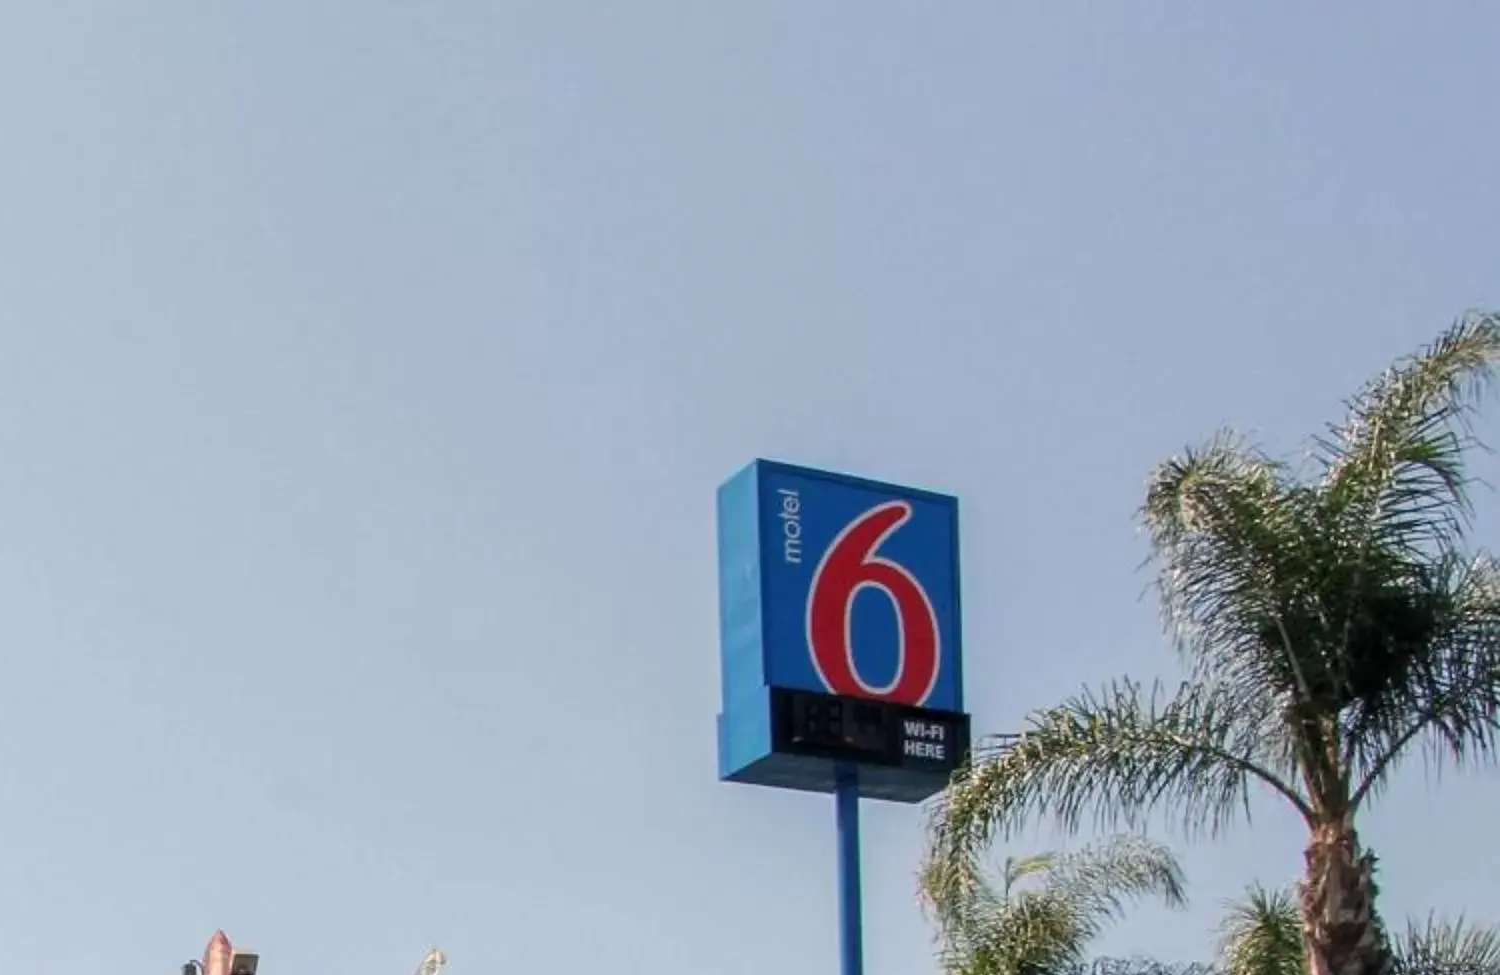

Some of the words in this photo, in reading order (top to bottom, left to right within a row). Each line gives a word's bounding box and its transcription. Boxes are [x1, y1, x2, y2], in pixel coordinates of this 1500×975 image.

[777, 488, 802, 564] motel
[806, 500, 941, 707] 6
[903, 721, 946, 740] WI-FI
[903, 740, 946, 759] HERE
